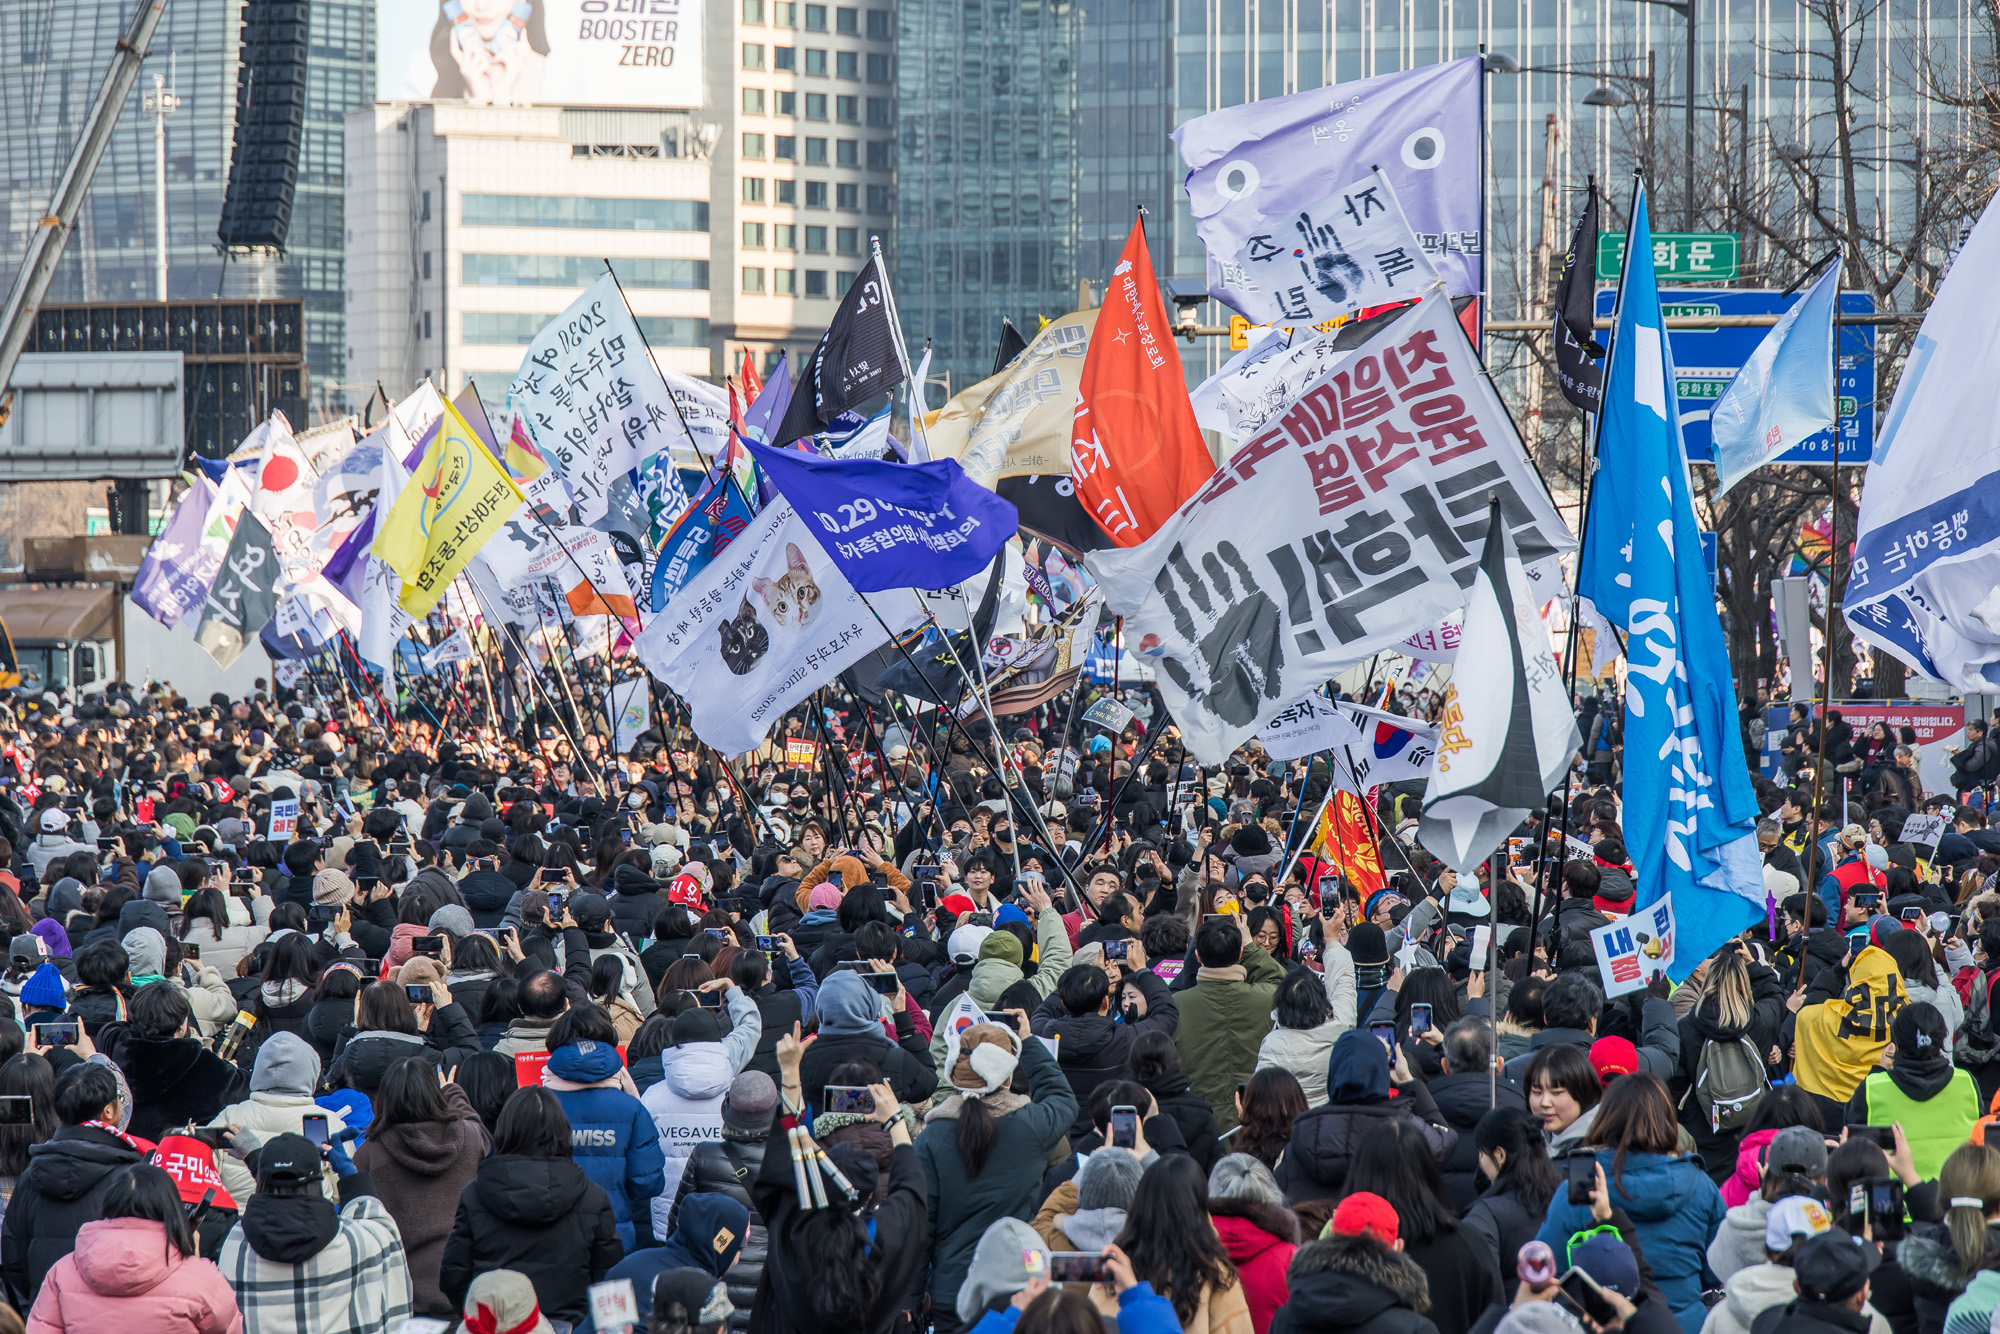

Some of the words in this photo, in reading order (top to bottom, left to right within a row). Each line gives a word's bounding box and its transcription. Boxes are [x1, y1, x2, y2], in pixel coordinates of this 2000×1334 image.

[579, 19, 678, 41] BOOSTER
[619, 45, 674, 67] ZERO
[1122, 277, 1165, 370] 대한예수교장로회
[1680, 383, 1725, 397] 광화문광
[1887, 716, 1911, 726] 서비스
[1912, 716, 1956, 727] 장비입니다.
[571, 1129, 616, 1146] WISS
[597, 1292, 627, 1317] 탄핵
